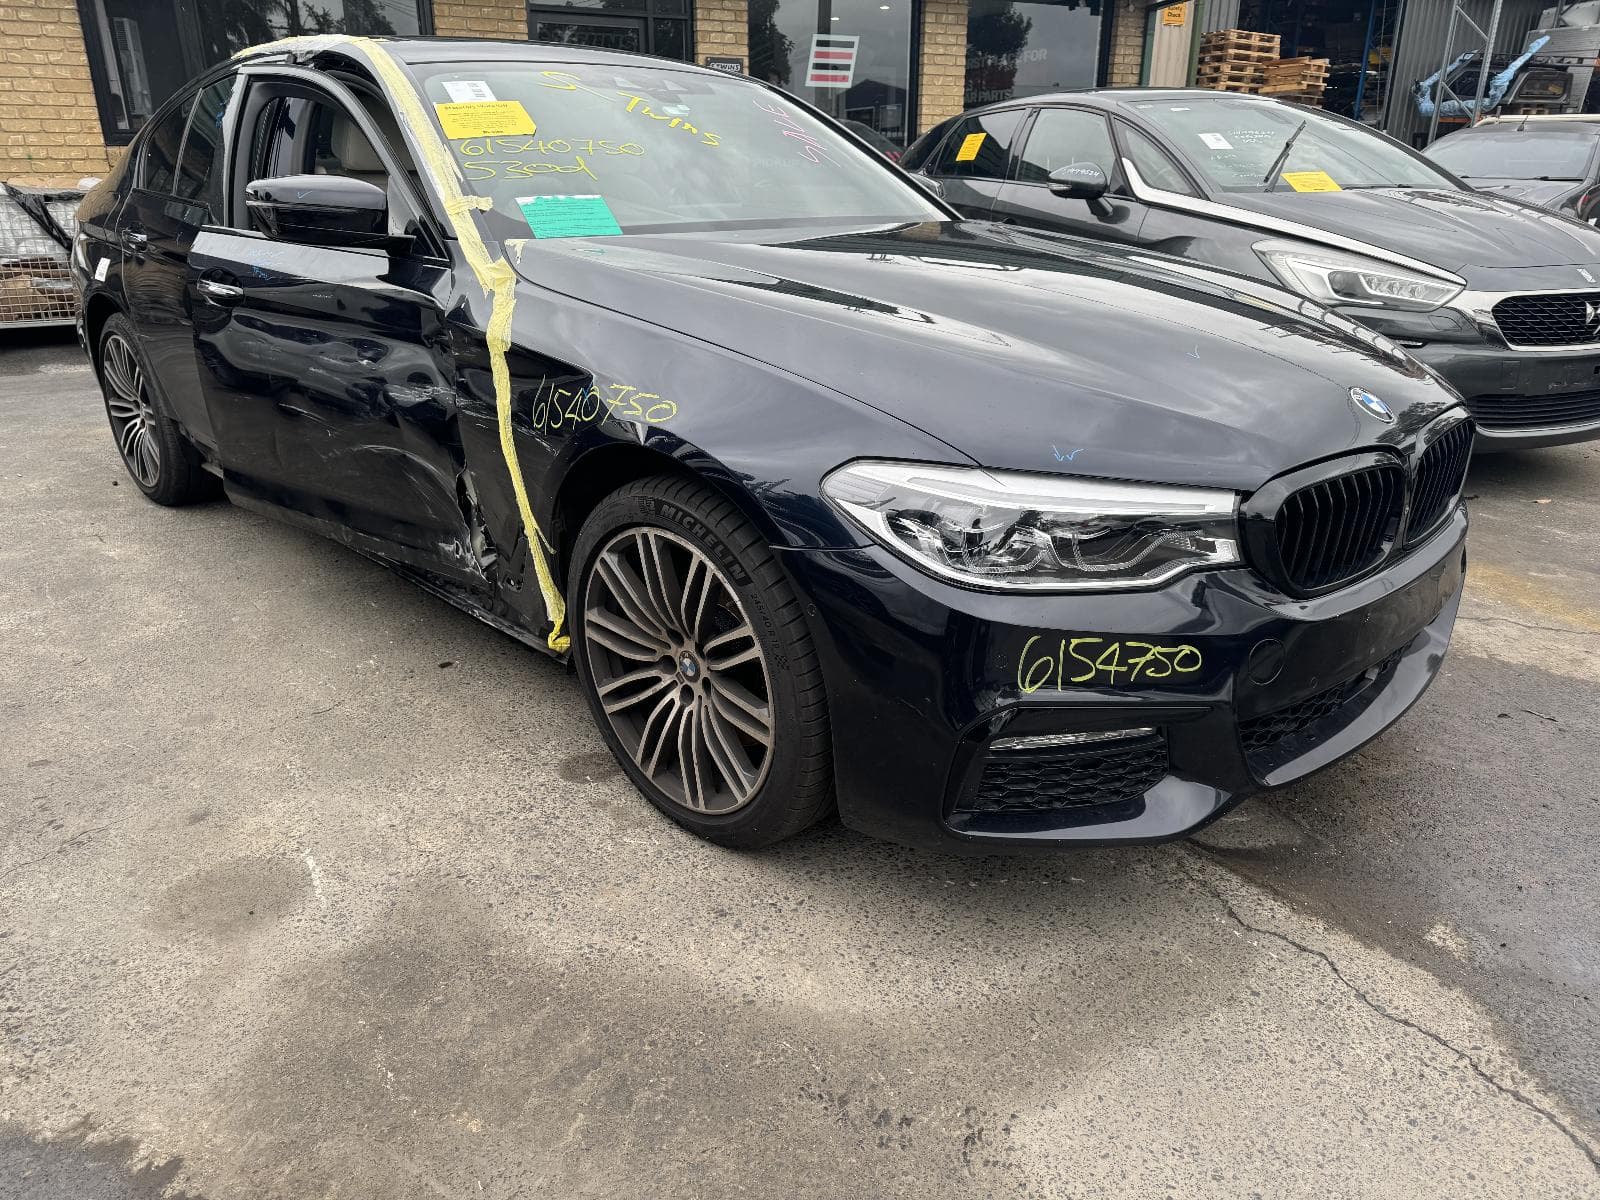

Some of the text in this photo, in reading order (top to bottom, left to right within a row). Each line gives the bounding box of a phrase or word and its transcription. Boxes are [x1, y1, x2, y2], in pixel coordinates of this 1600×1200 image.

[1022, 48, 1048, 62] FOR
[460, 138, 646, 156] 61540750
[533, 374, 679, 435] 61540750
[660, 503, 746, 580] MICHELIN
[1018, 635, 1203, 693] 6154750
